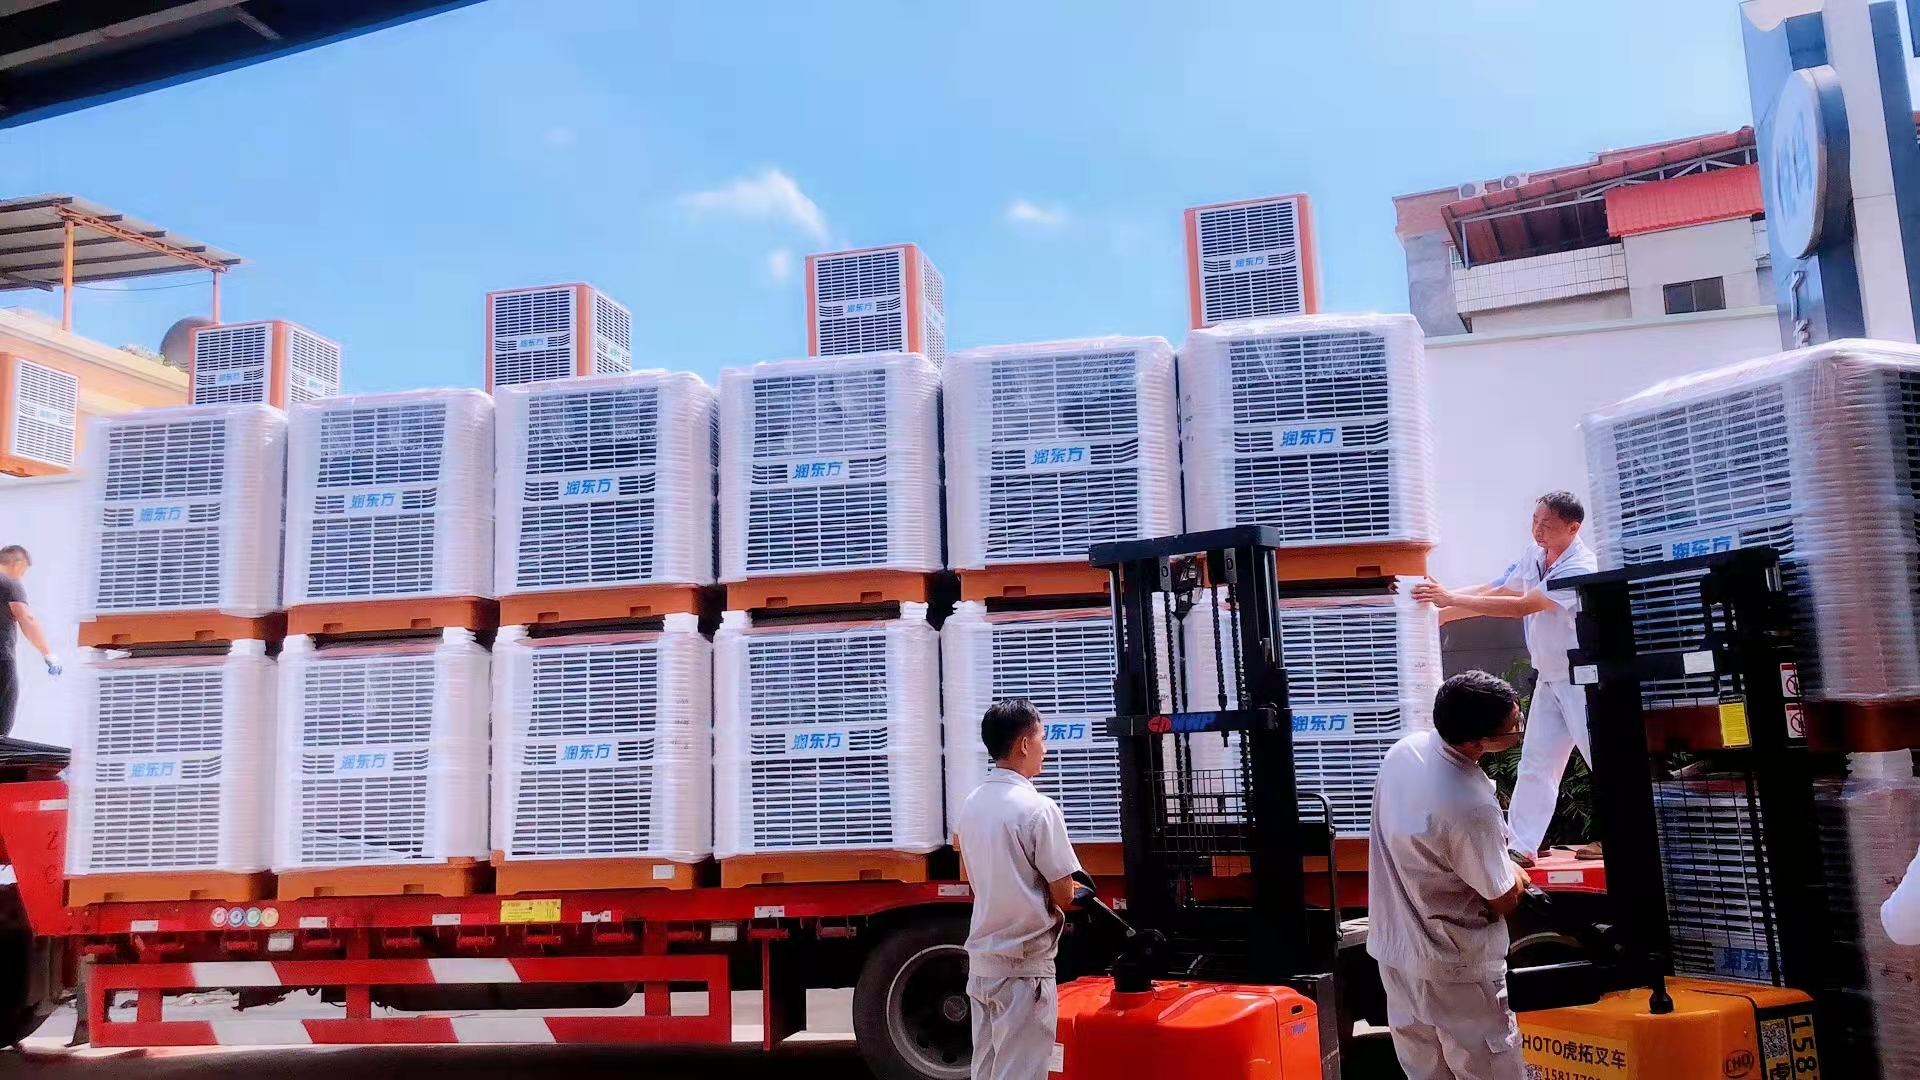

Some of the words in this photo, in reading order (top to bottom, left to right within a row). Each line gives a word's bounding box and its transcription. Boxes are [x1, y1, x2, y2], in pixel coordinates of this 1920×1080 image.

[1280, 428, 1336, 447] 润东方
[1030, 446, 1085, 465] 润东方
[793, 461, 843, 479] 润东方
[563, 477, 614, 495] 润东方
[350, 492, 396, 509] 润东方
[139, 506, 184, 522] 润东方
[1292, 714, 1348, 732] 润东方
[792, 732, 843, 750] 润东方
[562, 743, 613, 761] 润东方
[130, 762, 177, 777] 润东方
[339, 753, 388, 770] 润东方
[1521, 1033, 1627, 1069] HOTO虎拓叉车
[1790, 1015, 1818, 1080] 158
